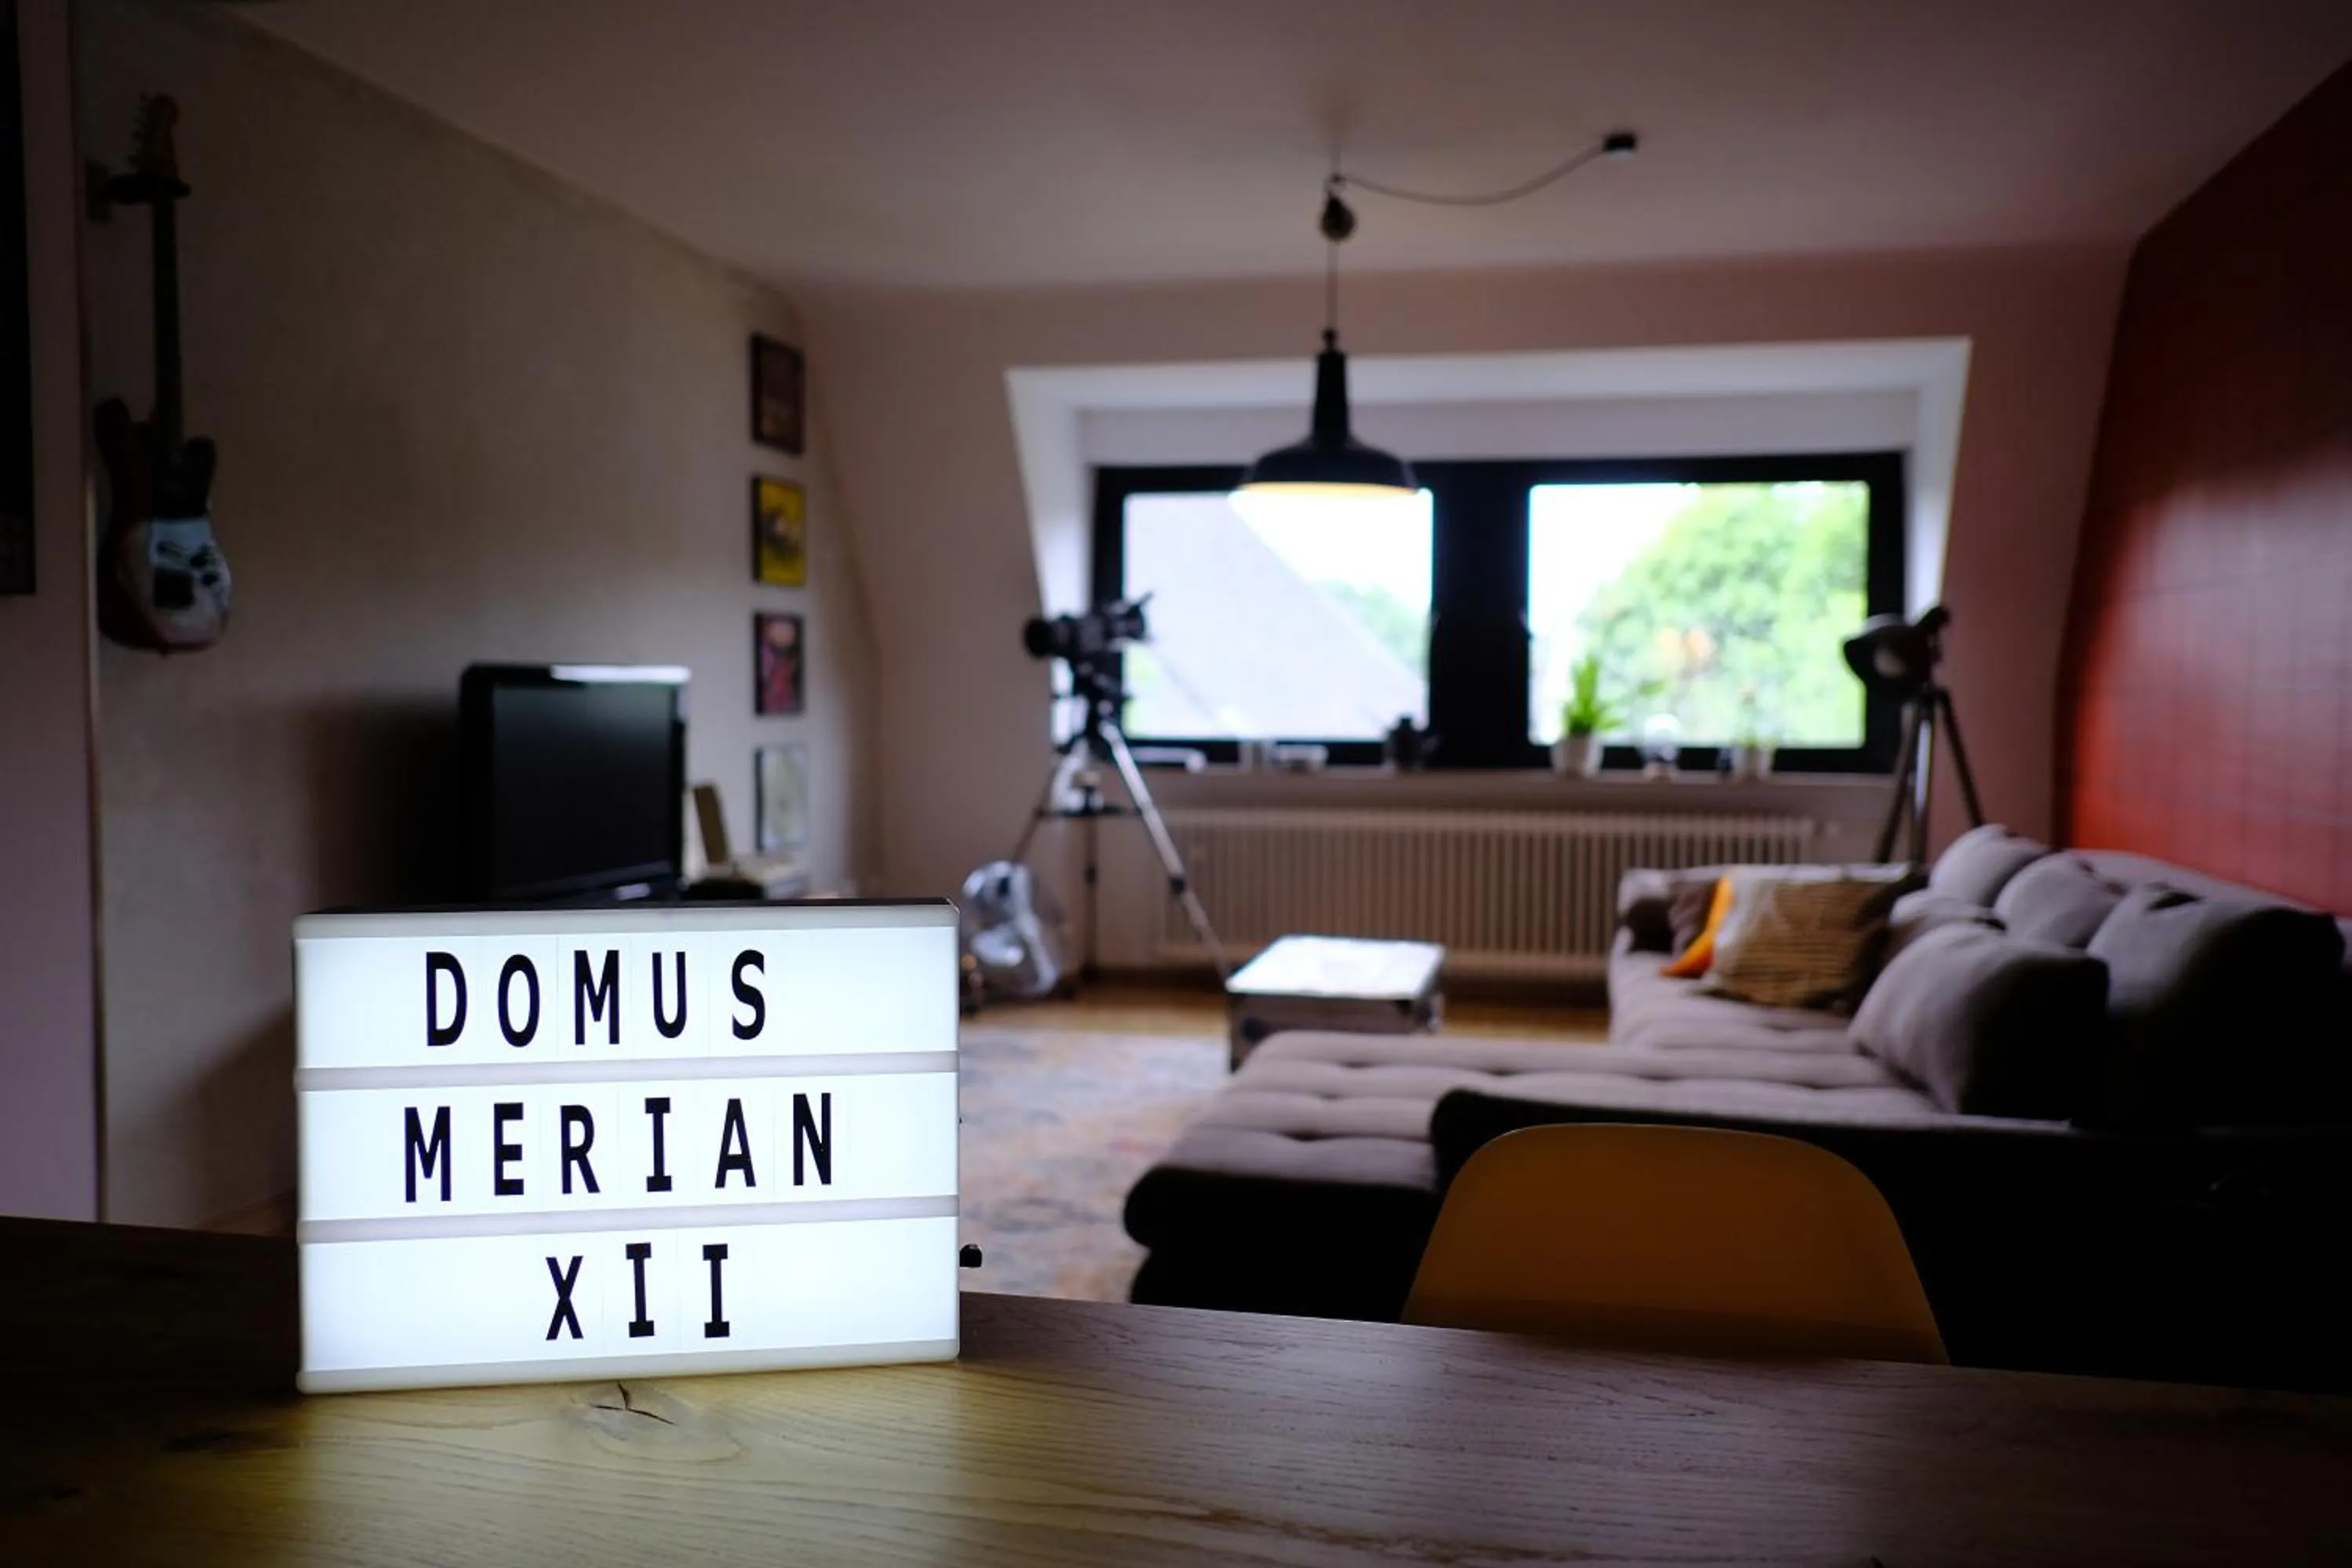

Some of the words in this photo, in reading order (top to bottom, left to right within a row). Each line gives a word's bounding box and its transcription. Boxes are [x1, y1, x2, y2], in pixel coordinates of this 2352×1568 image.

[426, 949, 765, 1047] DOMUS
[405, 1092, 832, 1203] MERIAN
[546, 1242, 730, 1341] XII
